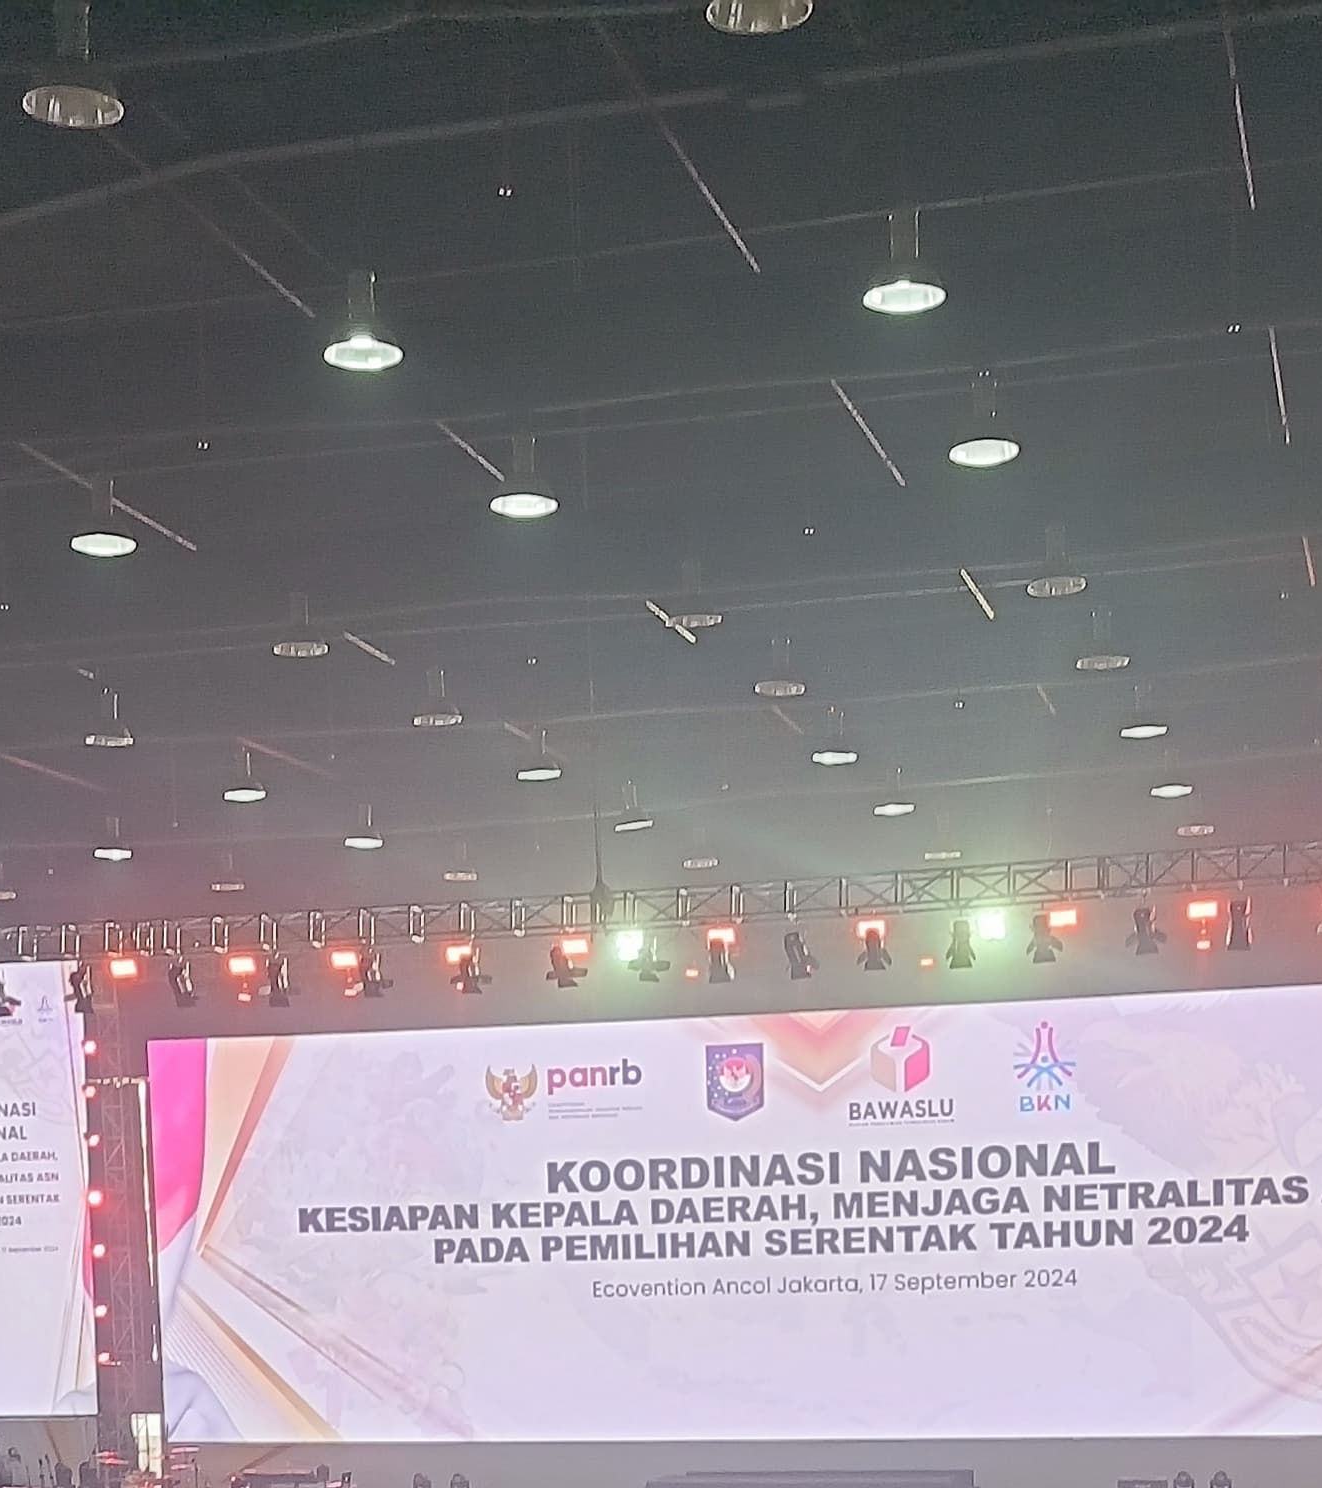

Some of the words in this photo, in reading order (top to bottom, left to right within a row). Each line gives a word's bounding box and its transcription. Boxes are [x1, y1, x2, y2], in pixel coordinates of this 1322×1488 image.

[548, 1059, 642, 1096] panrb
[849, 1098, 954, 1121] BAWASLU
[1020, 1094, 1071, 1112] BKN
[37, 1172, 59, 1182] ASN
[546, 1150, 842, 1195] KOORDINASI
[860, 1140, 1116, 1185] NASIONAL
[298, 1203, 480, 1234] KESIAPAN
[491, 1198, 640, 1230] KEPALA
[651, 1194, 820, 1227] DAERAH,
[832, 1186, 1030, 1221] MENJAGA
[1044, 1174, 1309, 1212] NETRALITAS
[433, 1236, 530, 1265] PADA
[541, 1230, 752, 1263] PEMILIHAN
[764, 1223, 977, 1258] SERENTAK
[990, 1219, 1135, 1251] TAHUN
[1147, 1213, 1251, 1247] 2024
[592, 1278, 708, 1299] Ecovention
[713, 1275, 772, 1297] Ancol
[776, 1273, 866, 1296] Jakarta,
[869, 1273, 887, 1292] 17
[894, 1270, 1017, 1295] September
[1024, 1268, 1078, 1289] 2024
